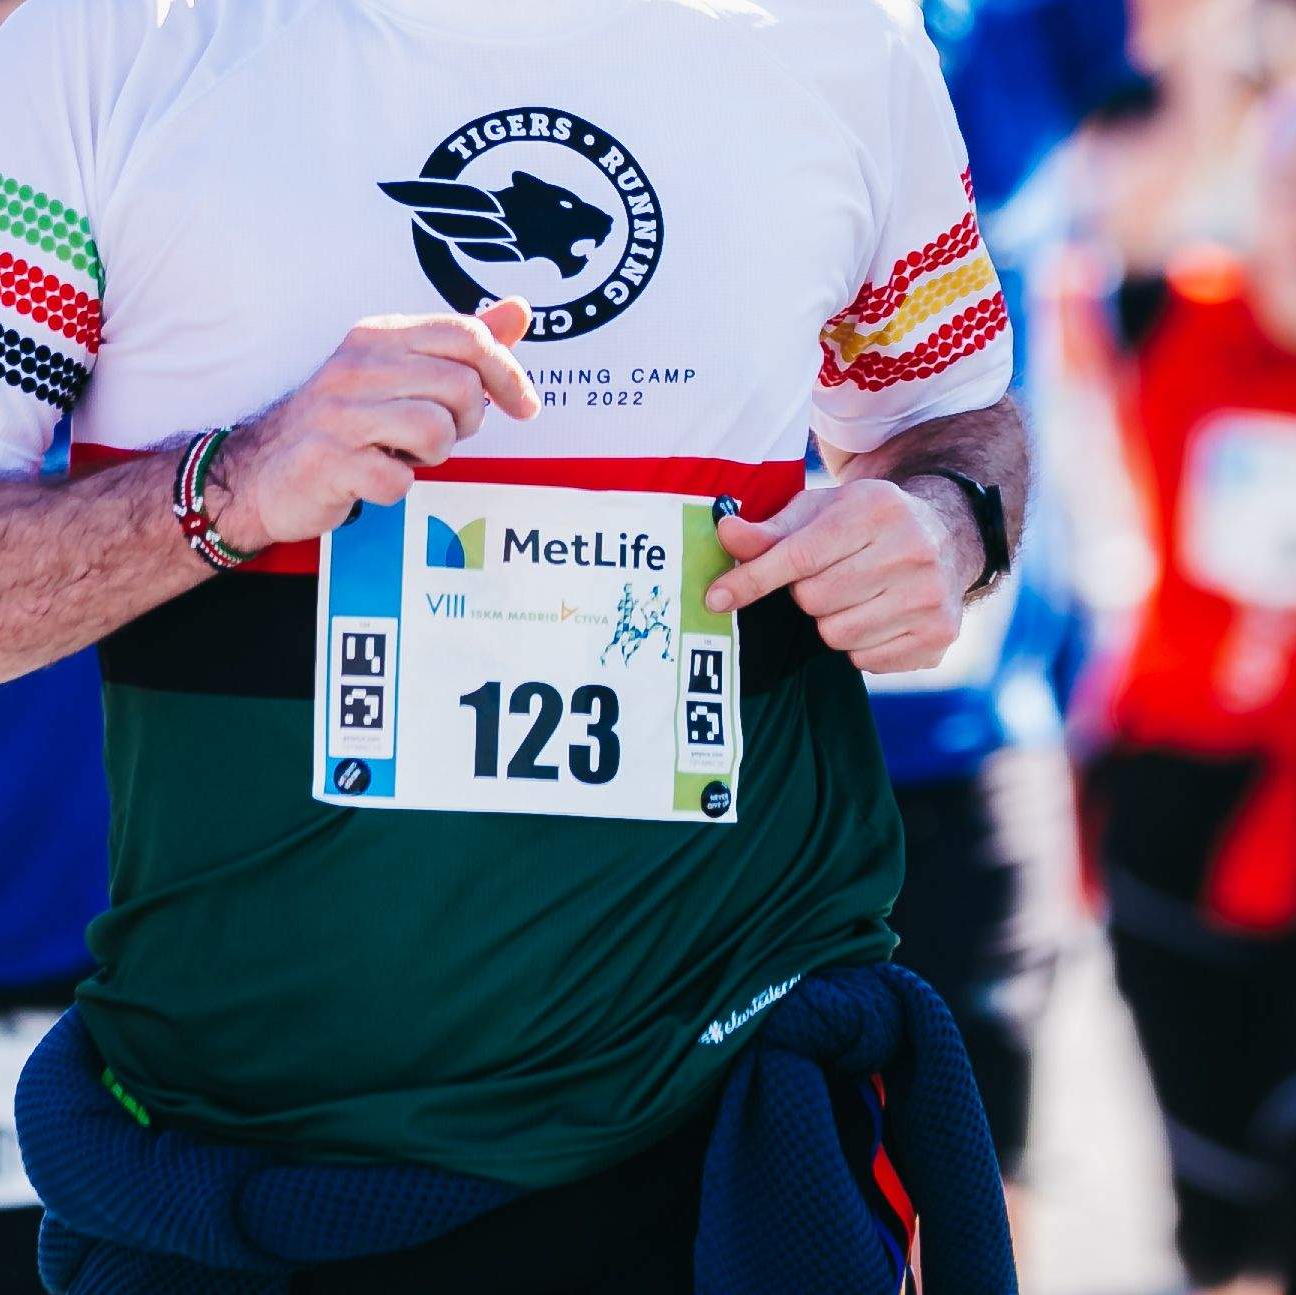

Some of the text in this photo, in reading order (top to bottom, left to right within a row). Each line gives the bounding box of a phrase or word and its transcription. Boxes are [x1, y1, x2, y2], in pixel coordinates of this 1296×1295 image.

[447, 112, 572, 160] TIGERS
[599, 145, 657, 305] RUNNING
[631, 368, 696, 384] CAMP
[587, 391, 644, 406] 2022
[503, 527, 666, 571] MetLife
[426, 593, 466, 618] VIII
[507, 609, 559, 623] MADRID
[459, 680, 621, 785] 123
